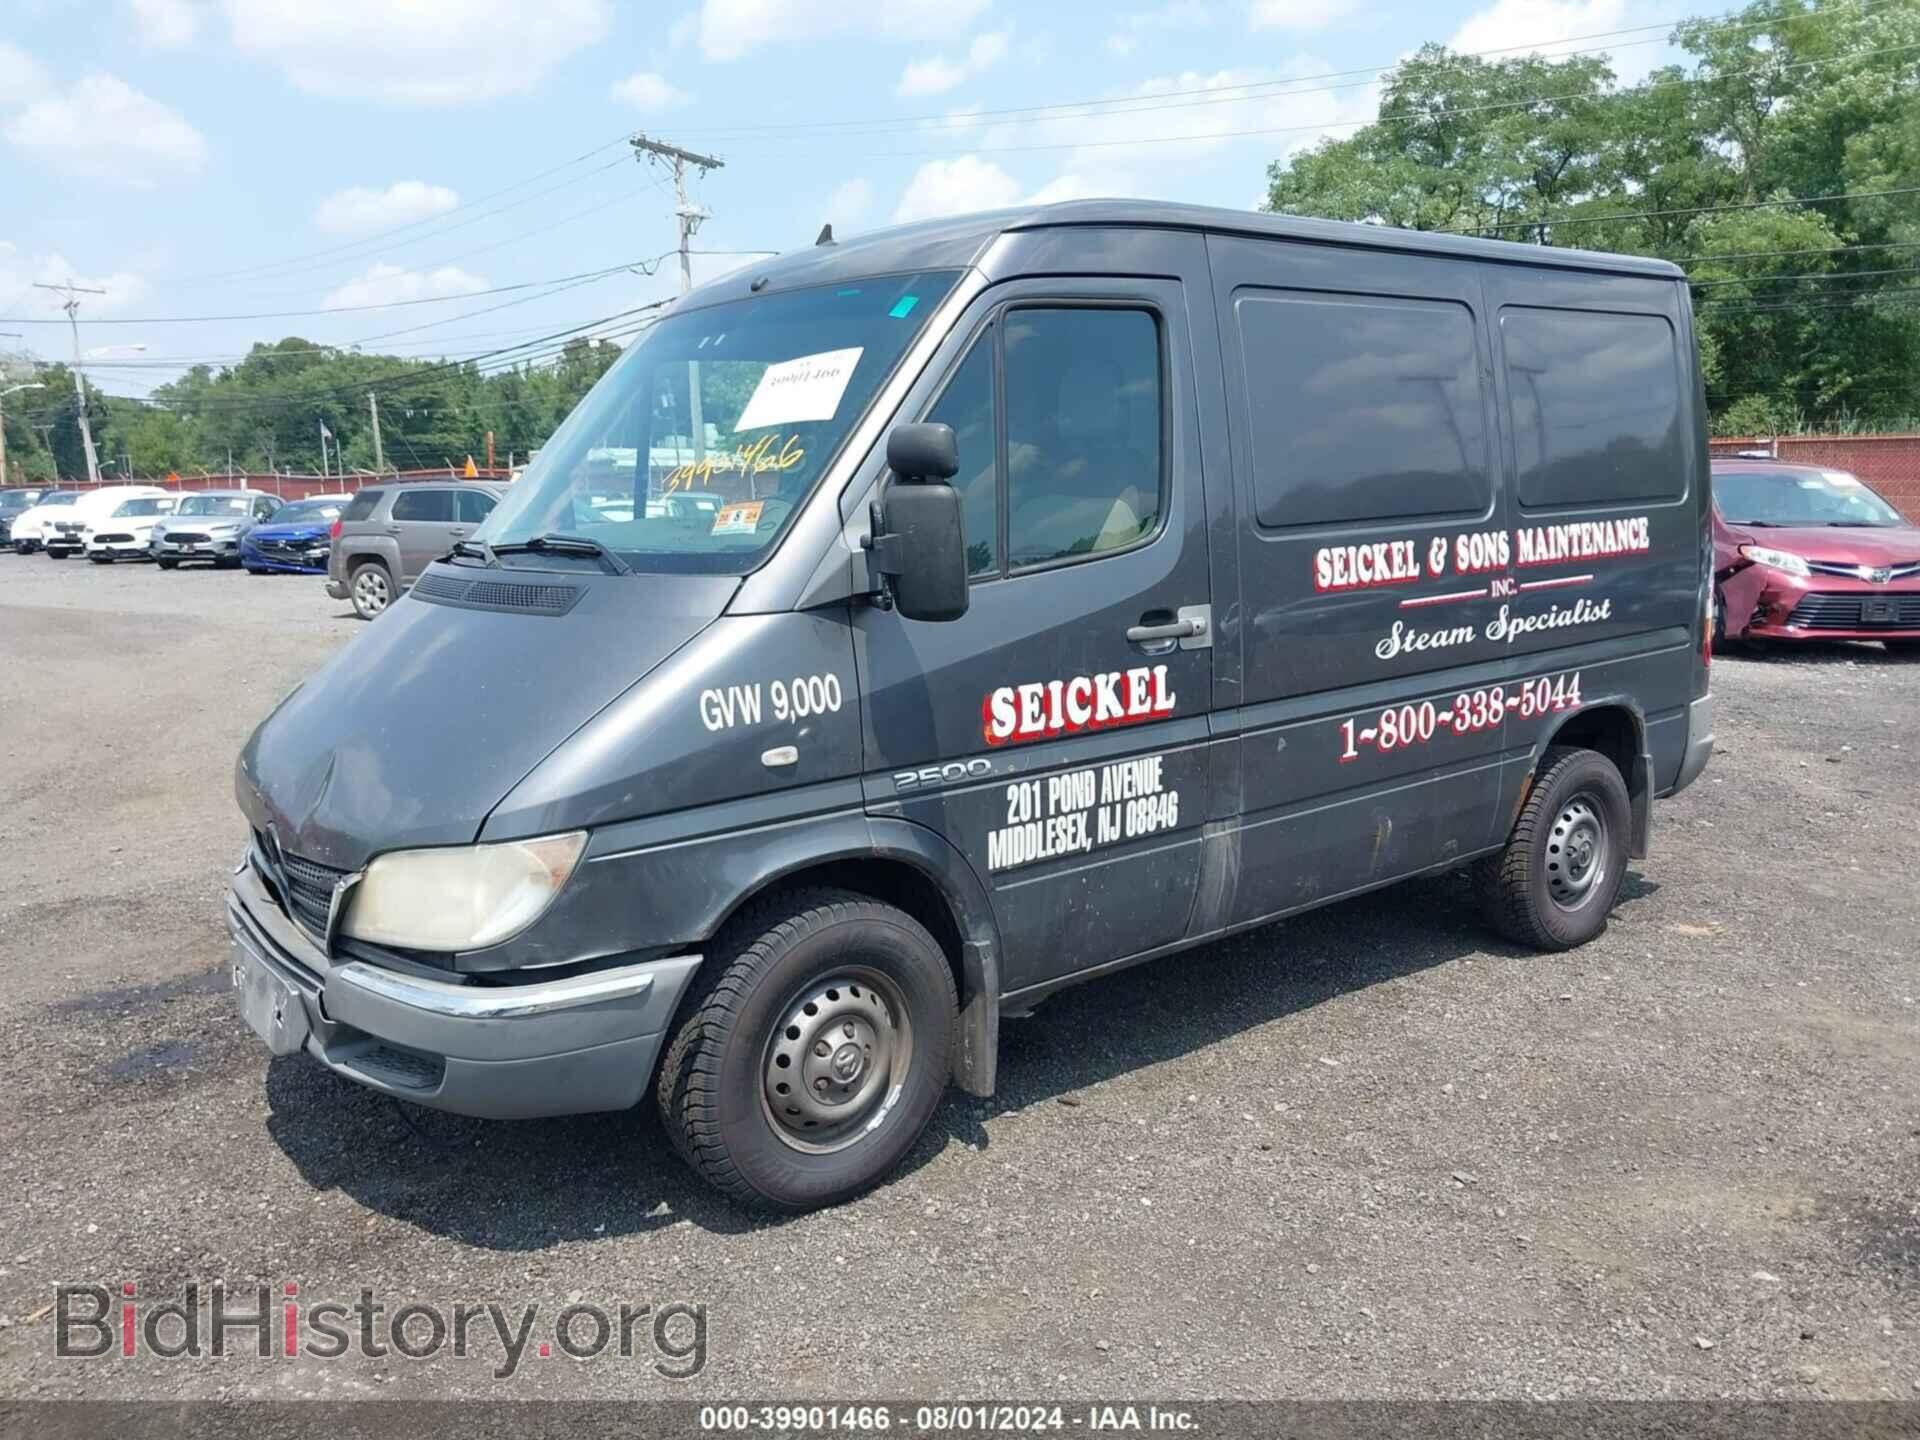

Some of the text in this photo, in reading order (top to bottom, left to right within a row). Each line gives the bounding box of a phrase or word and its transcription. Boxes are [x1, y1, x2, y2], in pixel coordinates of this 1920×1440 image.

[1314, 517, 1649, 591] SEICKEL & SONS MAINTENANCE
[1491, 578, 1518, 598] INC.
[1375, 598, 1612, 660] Steam Specialist
[700, 673, 842, 732] GVW 9,000
[985, 665, 1177, 742] SEICKEL
[894, 758, 992, 792] 2500
[1007, 756, 1164, 825] 201 POND AVENUE
[988, 790, 1179, 871] MIDDLESEX, NJ 08846
